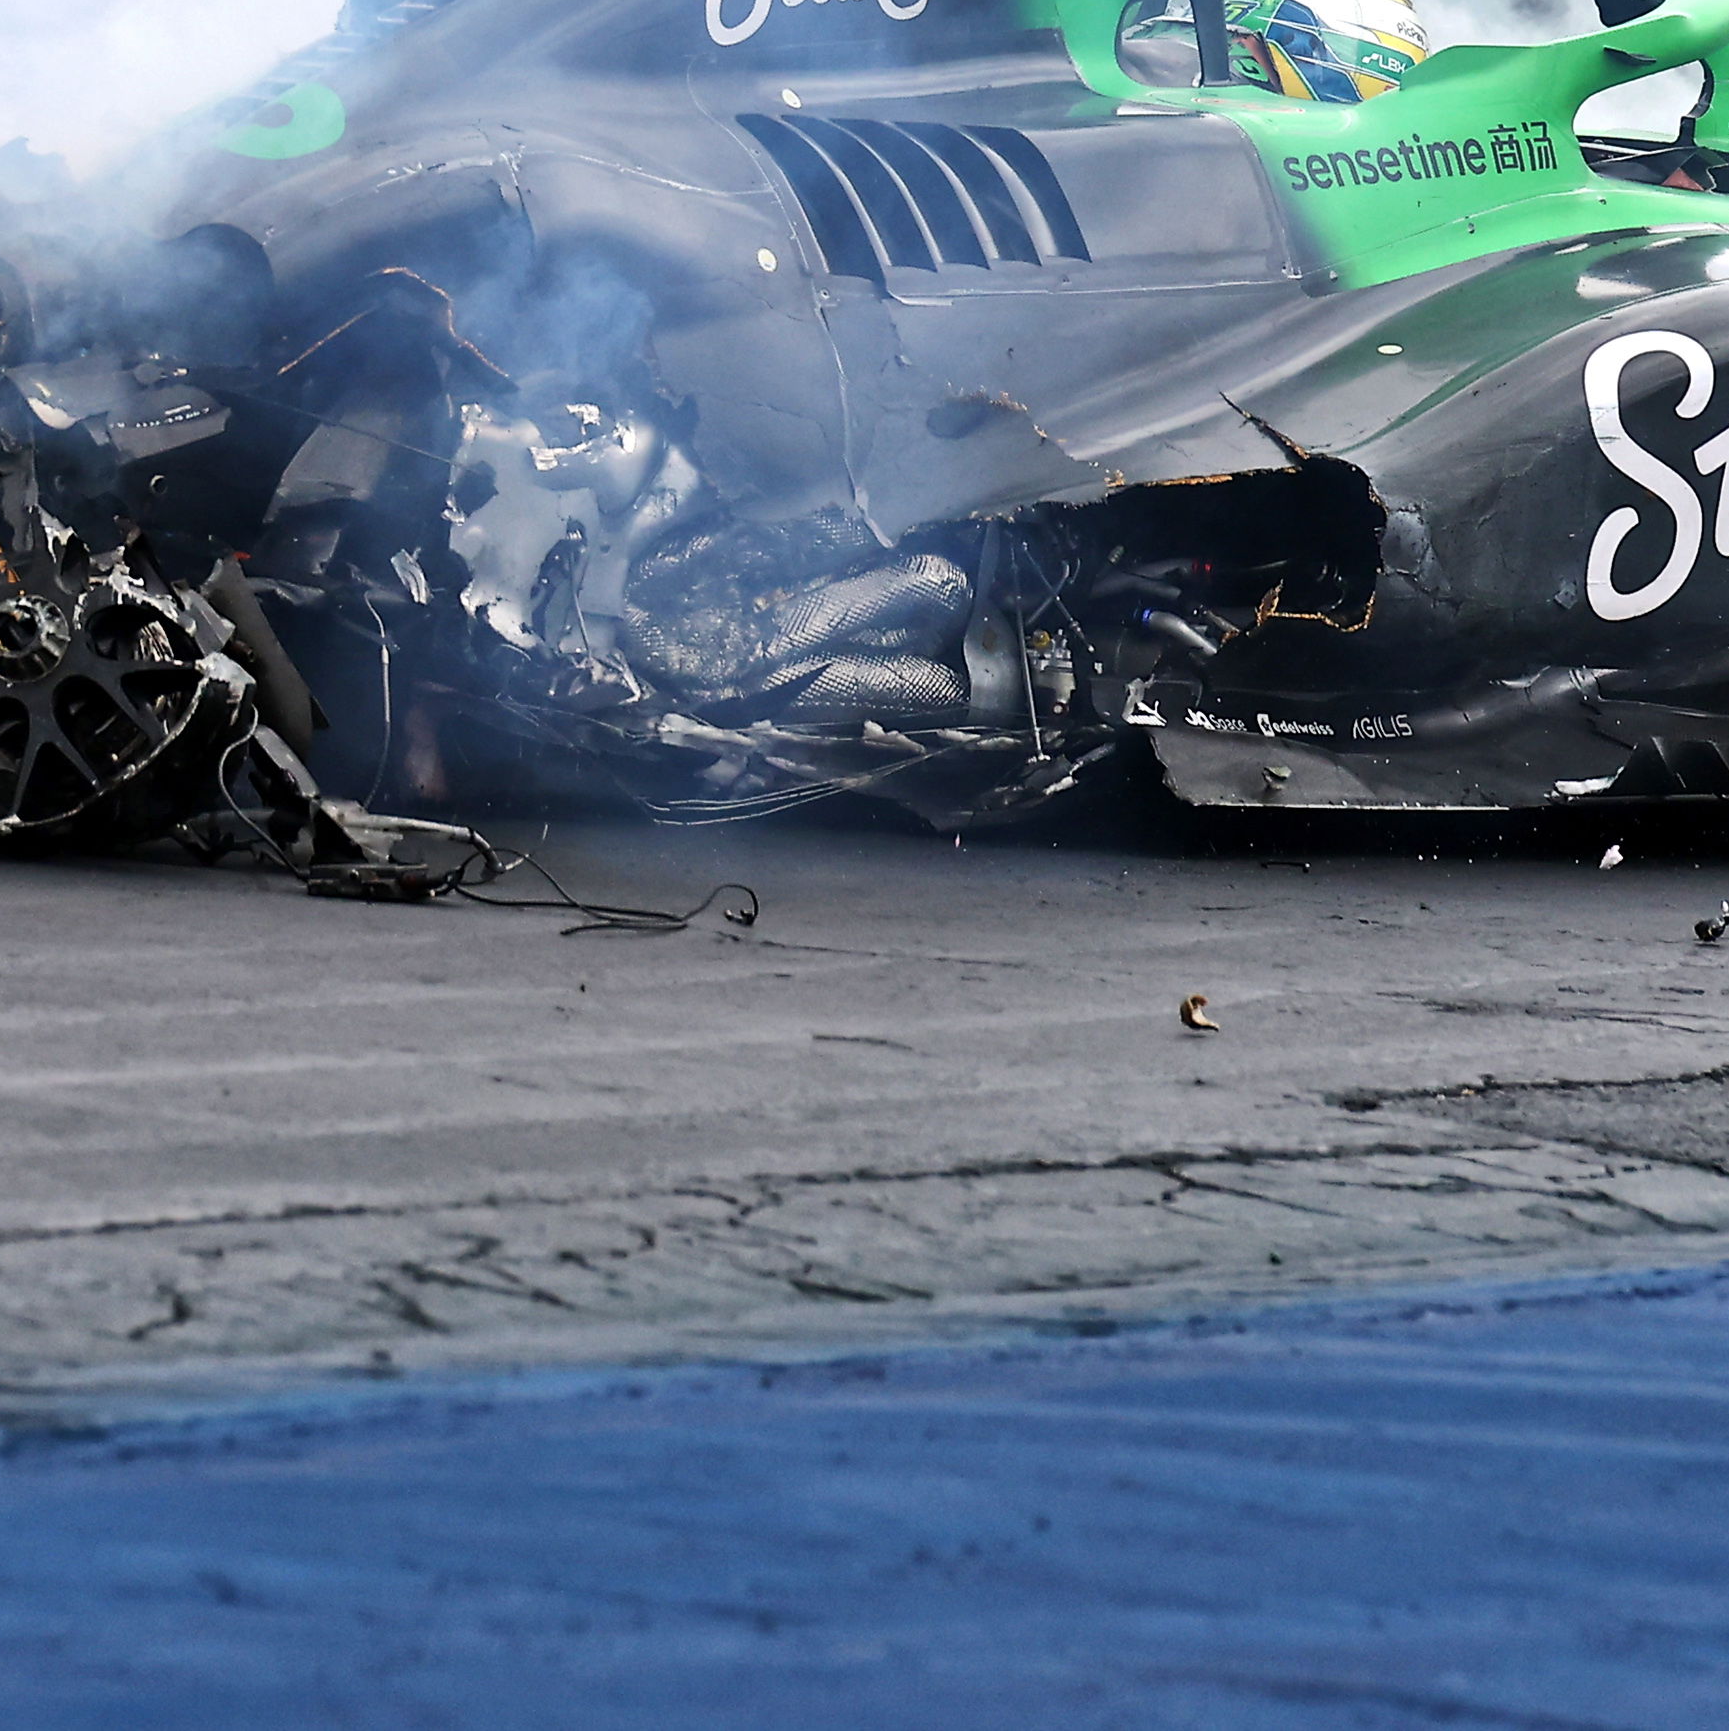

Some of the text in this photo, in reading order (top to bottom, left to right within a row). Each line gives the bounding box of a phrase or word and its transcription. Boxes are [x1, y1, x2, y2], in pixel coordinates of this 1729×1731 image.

[1283, 133, 1487, 192] sensetime
[1272, 721, 1335, 737] edelweiss
[1351, 713, 1414, 740] AGILIS
